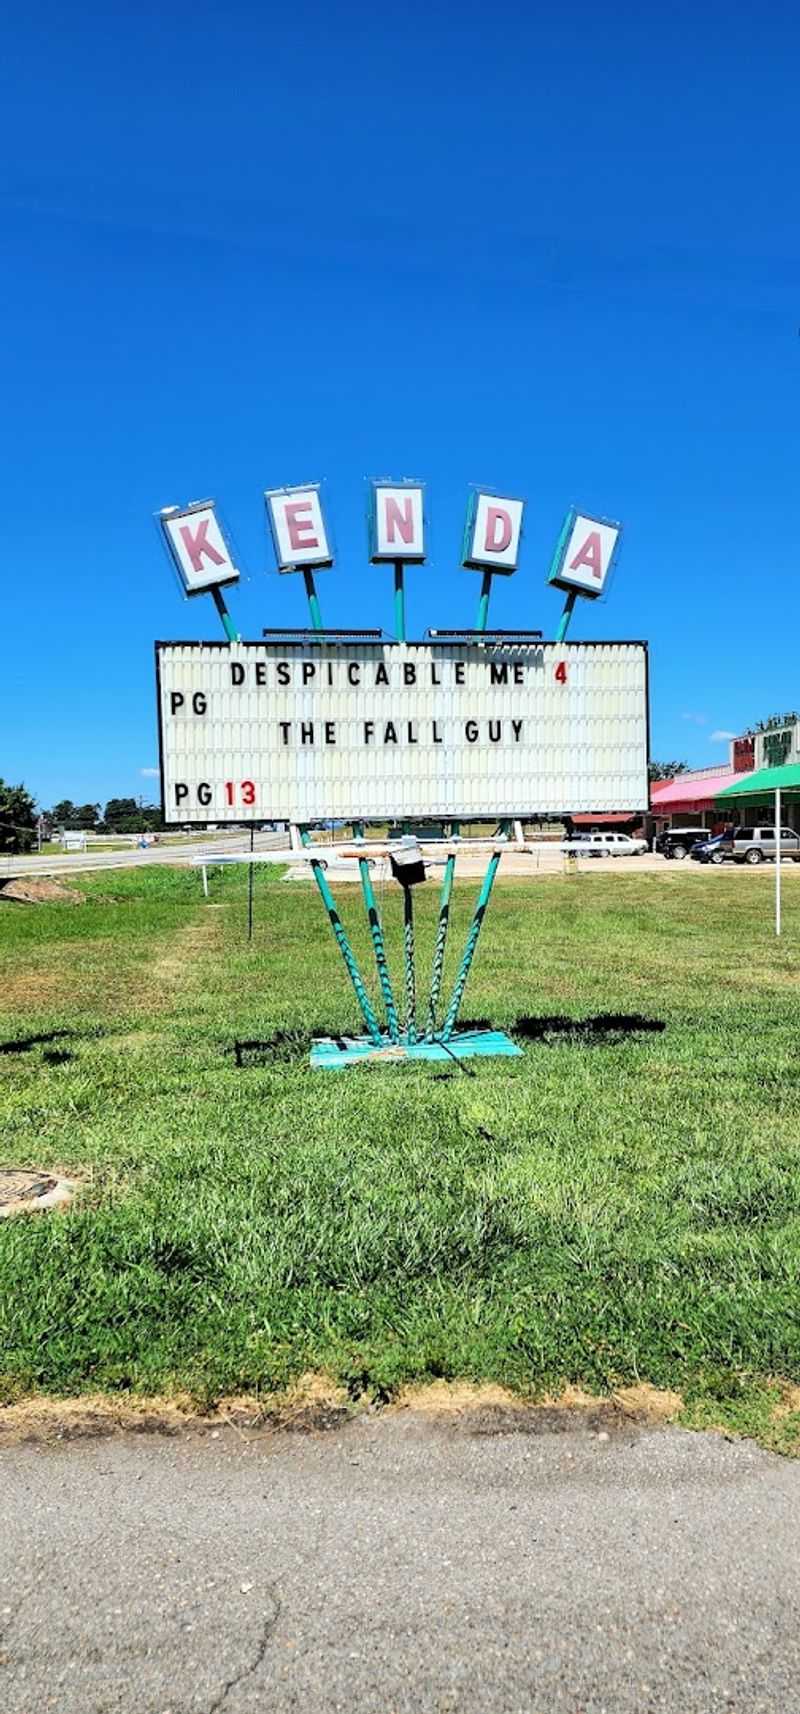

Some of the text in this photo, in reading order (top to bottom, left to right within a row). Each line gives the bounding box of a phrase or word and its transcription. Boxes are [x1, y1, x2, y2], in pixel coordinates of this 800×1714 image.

[179, 497, 602, 579] KENDA
[231, 661, 568, 686] DESPICABLE ME 4
[171, 692, 207, 715] PG
[279, 720, 525, 745] THE FALL GUY
